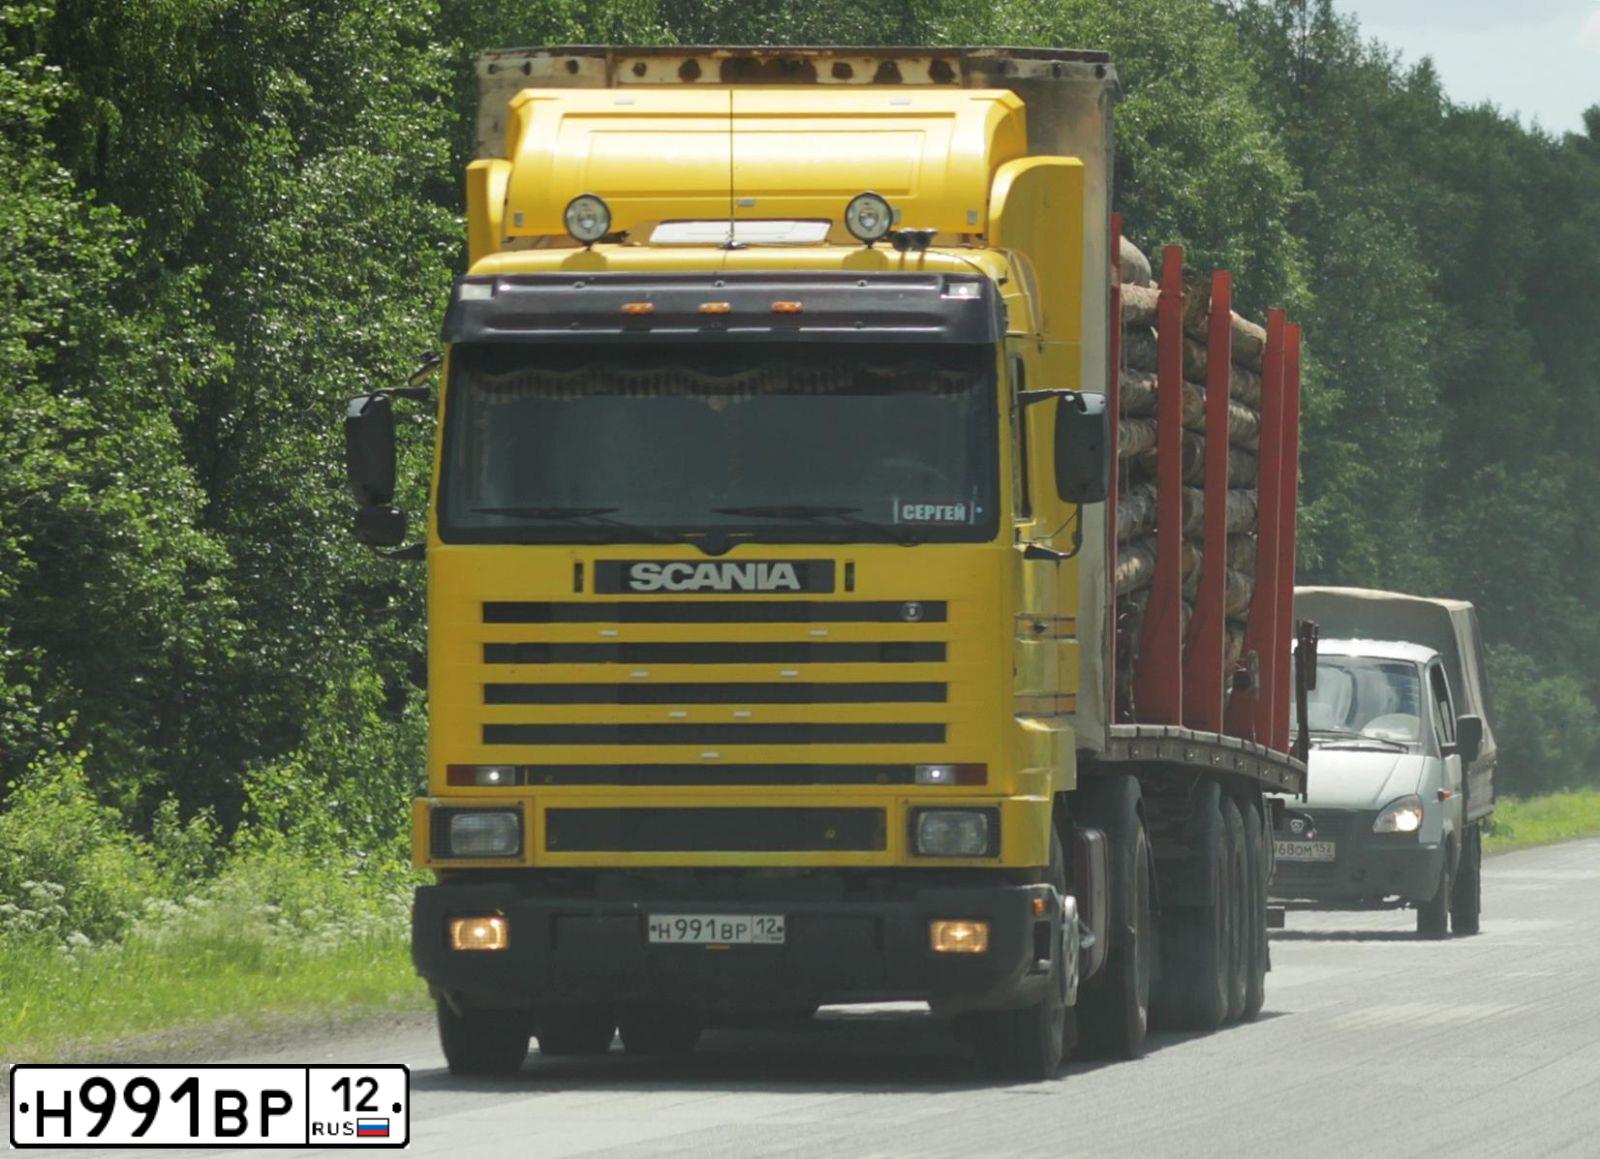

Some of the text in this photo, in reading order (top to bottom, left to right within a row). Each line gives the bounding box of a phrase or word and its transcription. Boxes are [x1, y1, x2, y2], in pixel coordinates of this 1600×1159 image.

[902, 503, 966, 521] СЕРГЕЙ
[629, 562, 800, 591] SCANIA
[756, 918, 777, 934] 12
